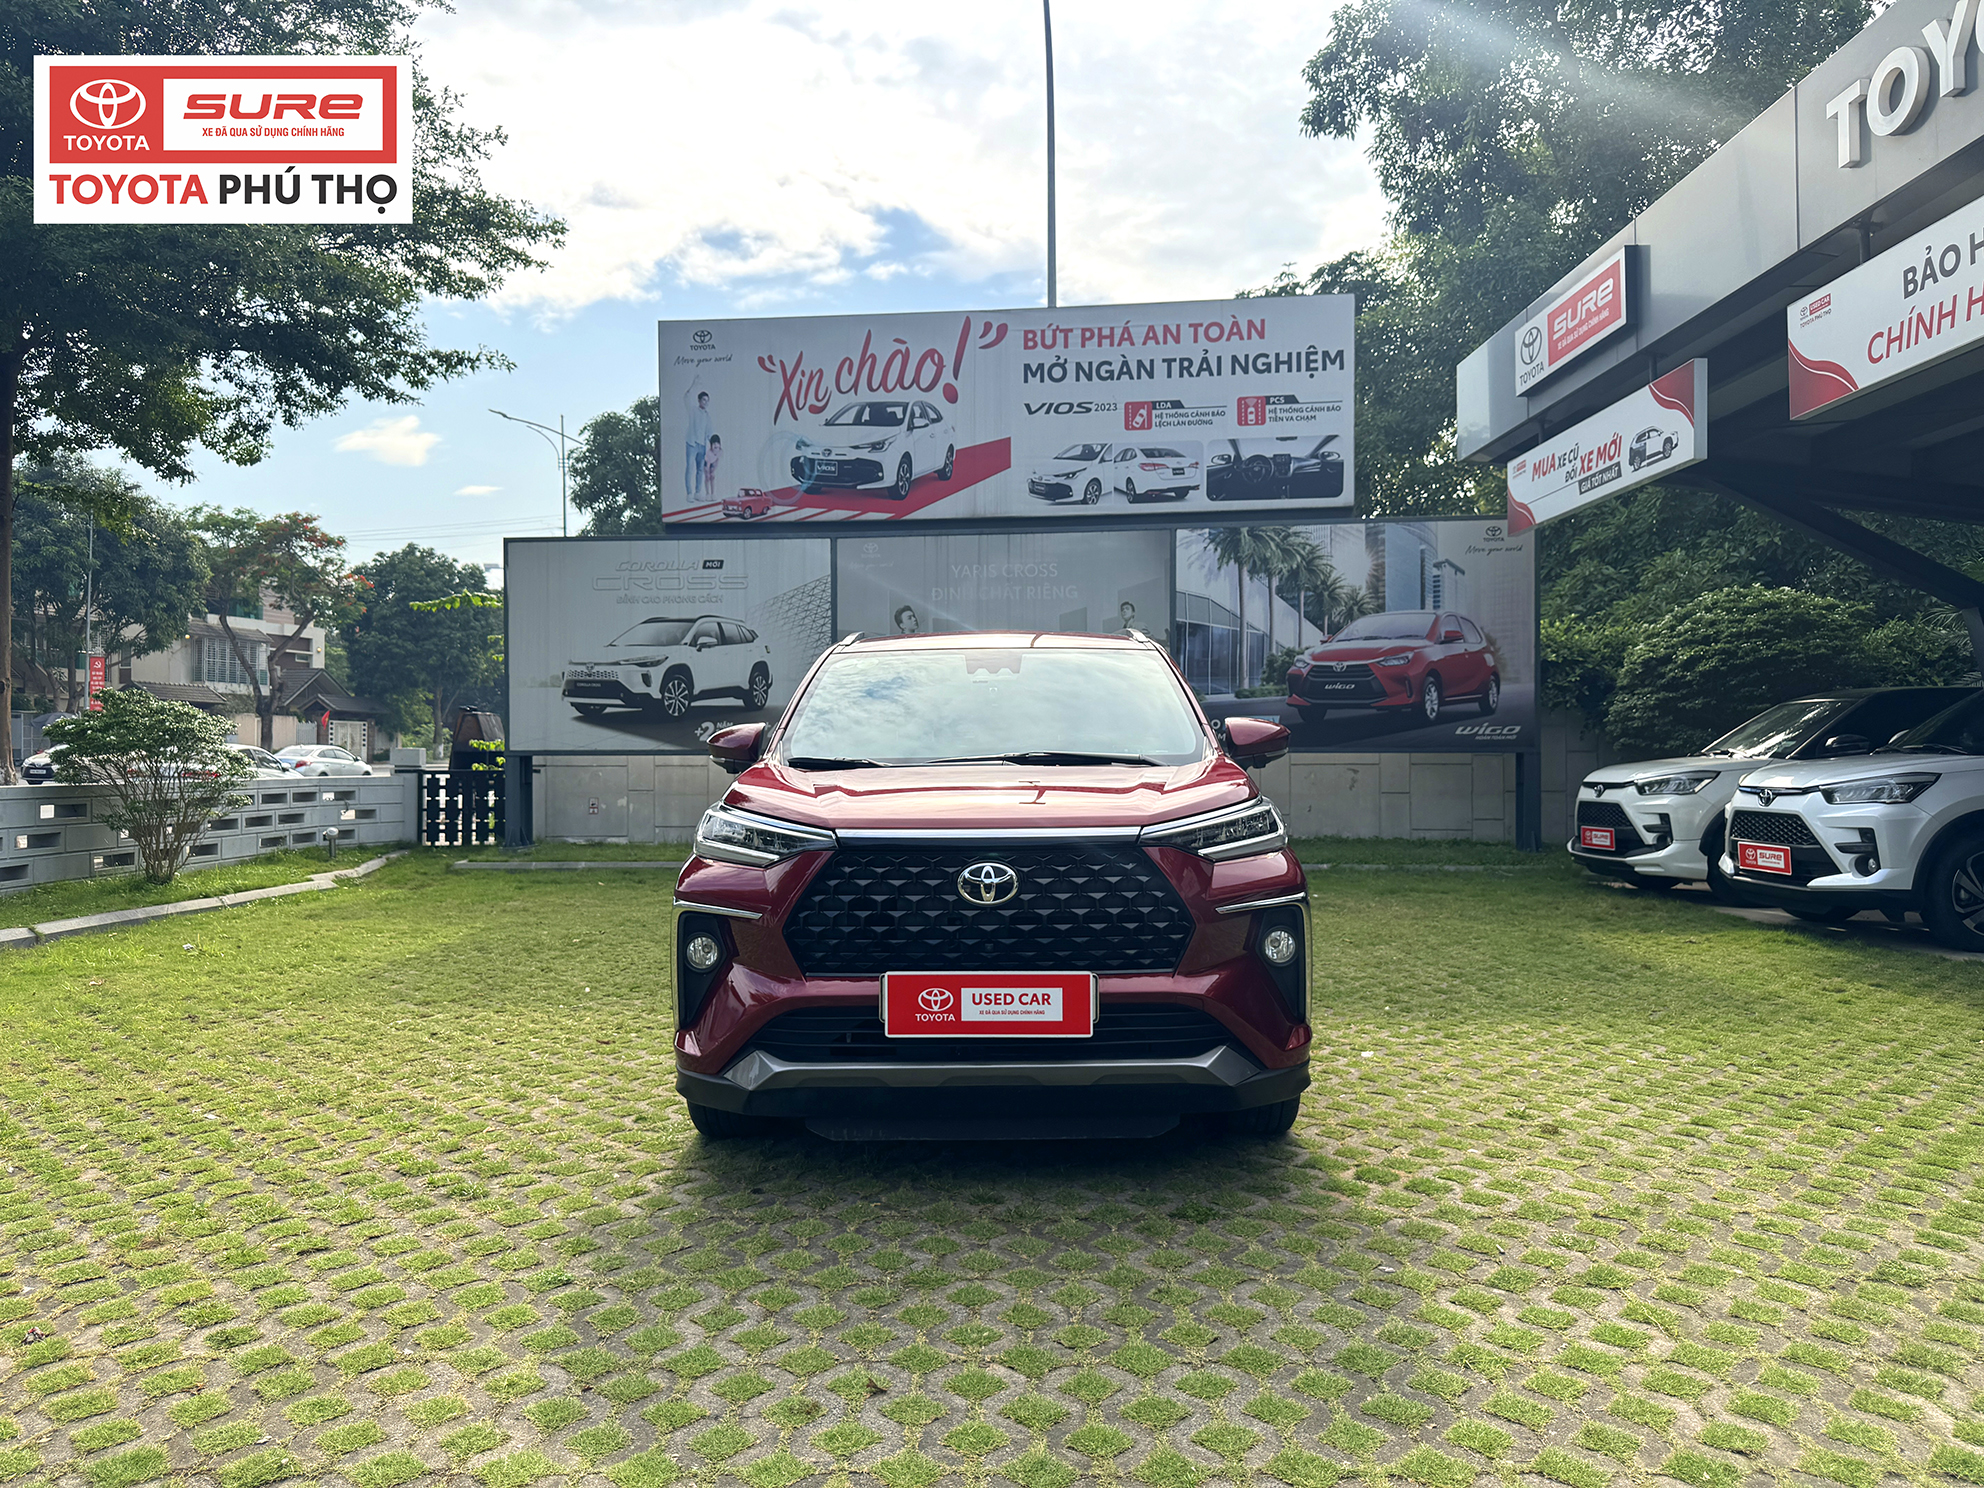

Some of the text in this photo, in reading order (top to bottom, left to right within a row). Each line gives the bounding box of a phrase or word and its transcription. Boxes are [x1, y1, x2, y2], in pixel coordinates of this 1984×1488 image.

[1826, 0, 1984, 168] TOY
[1903, 244, 1961, 300] BẢO
[1023, 314, 1266, 350] BỨT PHÁ AN TOÀN
[1867, 293, 1958, 364] CHÍNH
[690, 343, 716, 351] TOYOTA
[1023, 345, 1345, 383] MỞ NGÀN TRẢI NGHIỆM
[1519, 361, 1545, 386] TOYOTA
[1023, 401, 1118, 415] VIOS 2023
[1154, 411, 1164, 420] HỆ
[1165, 410, 1189, 419] THỐNG
[1190, 409, 1210, 418] CẢNH
[1326, 404, 1341, 412] BÁO
[1295, 415, 1317, 423] CHẠM
[1532, 453, 1556, 482] MUA
[1556, 451, 1567, 470] XE
[1567, 442, 1579, 464] CŨ
[1565, 432, 1622, 483] ĐỔI XE MỚI
[1581, 465, 1619, 492] GIÁ TỐT NHẤT
[615, 560, 699, 572] COROLLA
[705, 560, 721, 568] MỚI
[951, 563, 1058, 579] YARIS CROSS
[592, 574, 748, 591] CROSS
[1026, 582, 1079, 600] RIÊNG
[971, 993, 1052, 1006] USED CAR
[915, 1013, 956, 1022] TOYOTA
